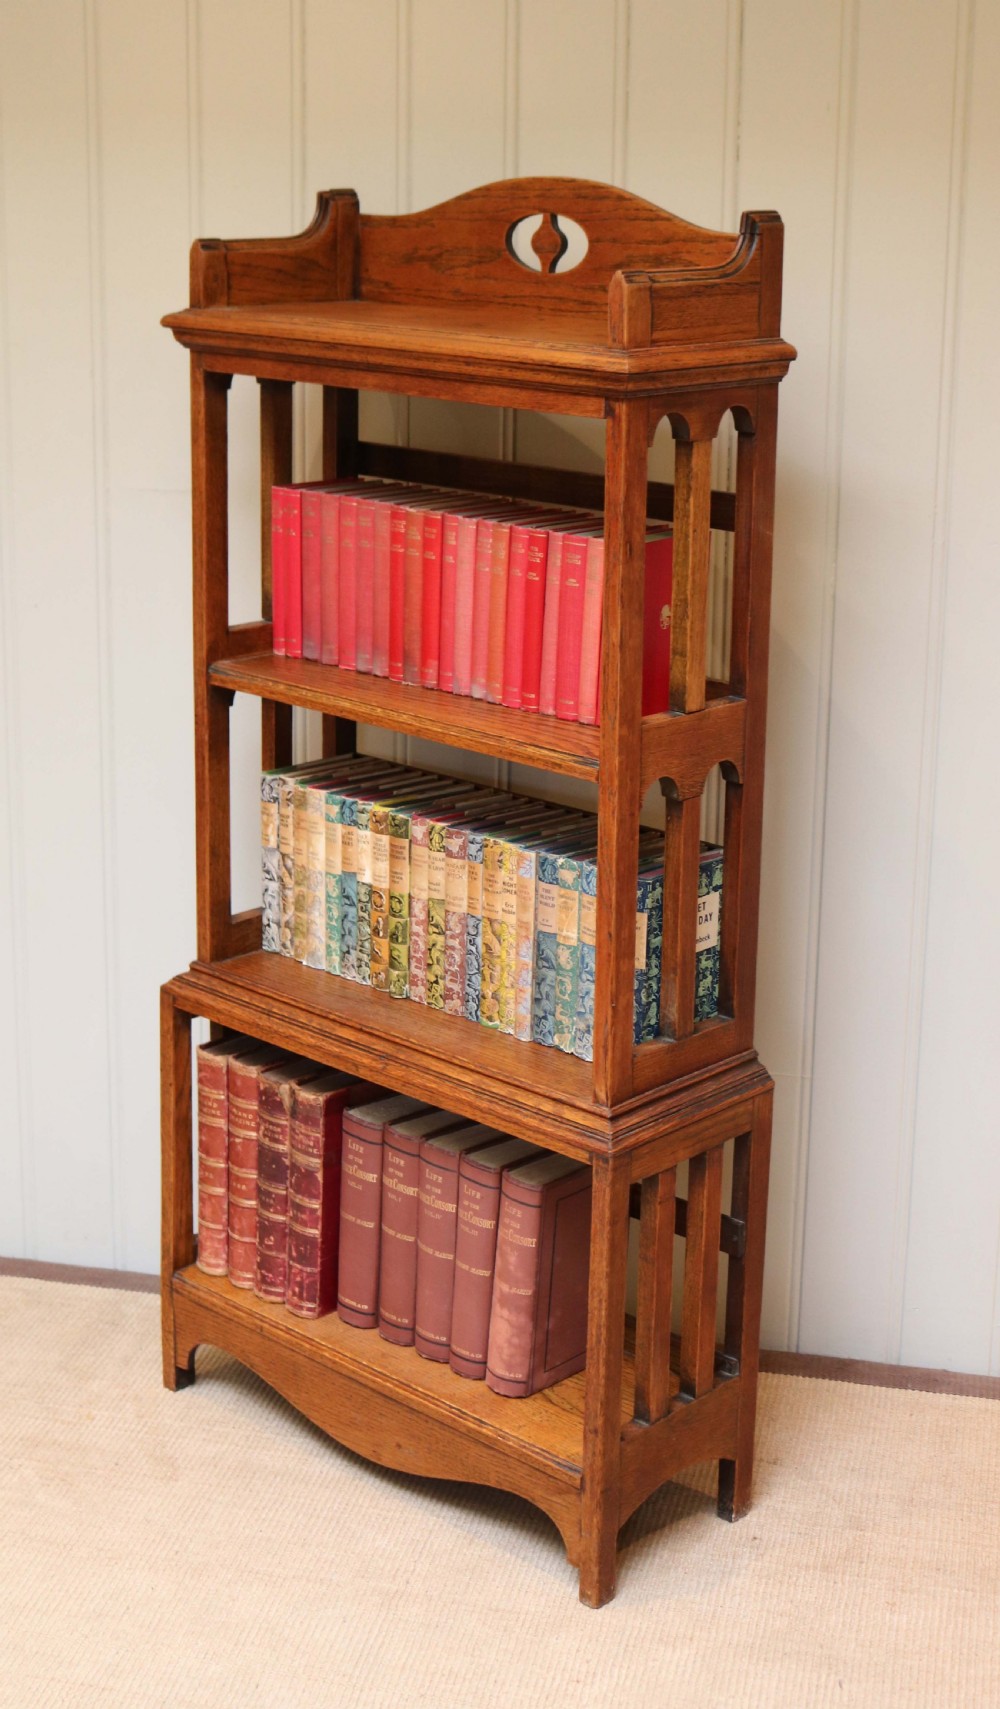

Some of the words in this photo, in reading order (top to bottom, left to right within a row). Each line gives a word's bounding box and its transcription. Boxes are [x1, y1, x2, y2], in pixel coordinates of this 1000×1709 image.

[698, 911, 713, 926] DAY
[348, 1139, 364, 1154] LIFE
[388, 1151, 405, 1167] LIFE
[425, 1168, 443, 1184] LIFE
[464, 1184, 481, 1199] LIFE
[504, 1201, 522, 1218] LIFE
